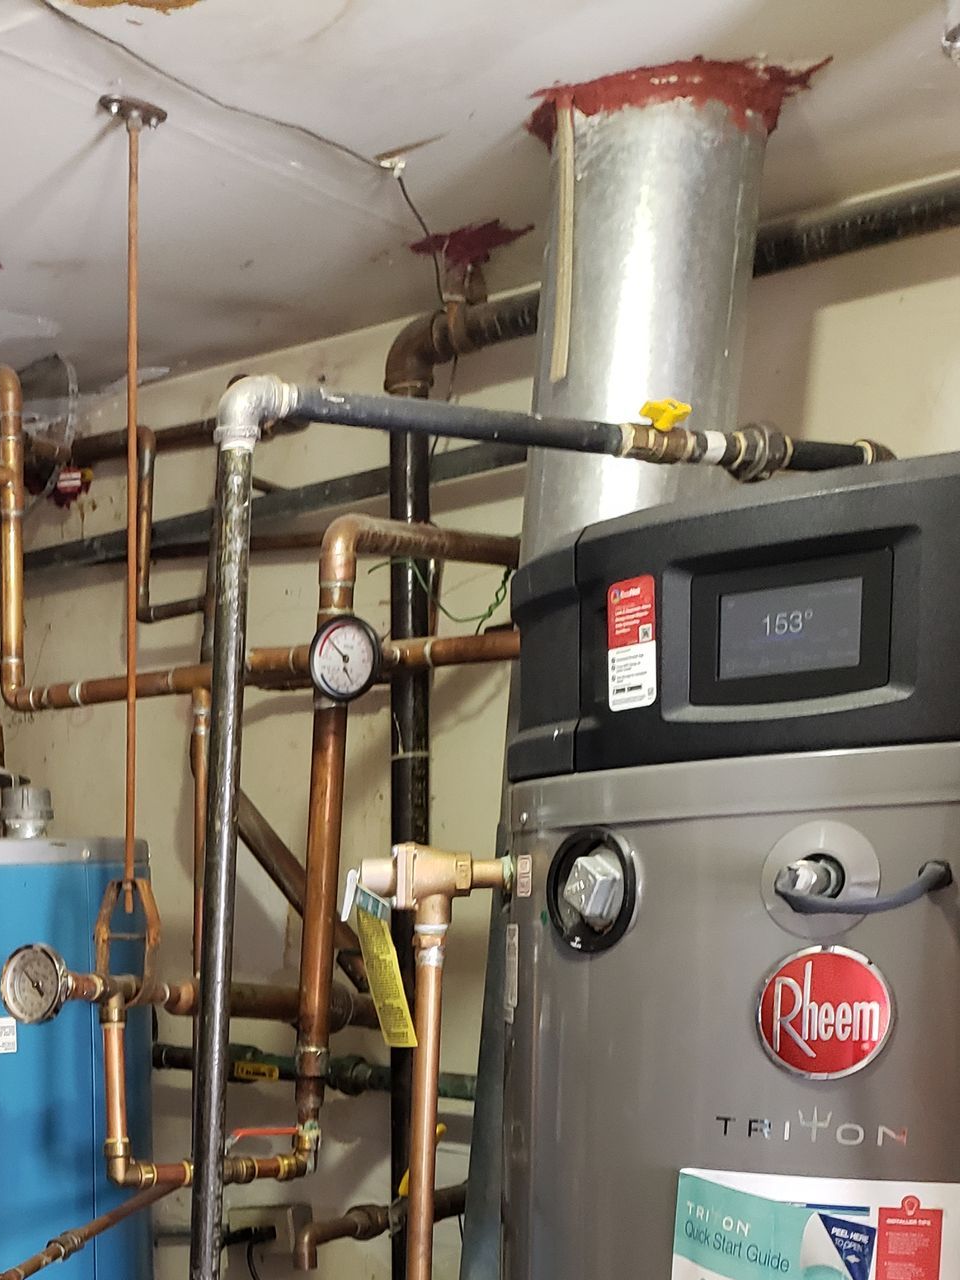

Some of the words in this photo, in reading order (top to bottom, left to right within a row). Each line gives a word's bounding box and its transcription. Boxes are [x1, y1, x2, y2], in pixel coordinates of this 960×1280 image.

[772, 960, 880, 1058] Rheem
[686, 1199, 751, 1237] TRION
[684, 1220, 710, 1247] Quick
[713, 1232, 743, 1258] Start
[746, 1244, 790, 1273] Guide
